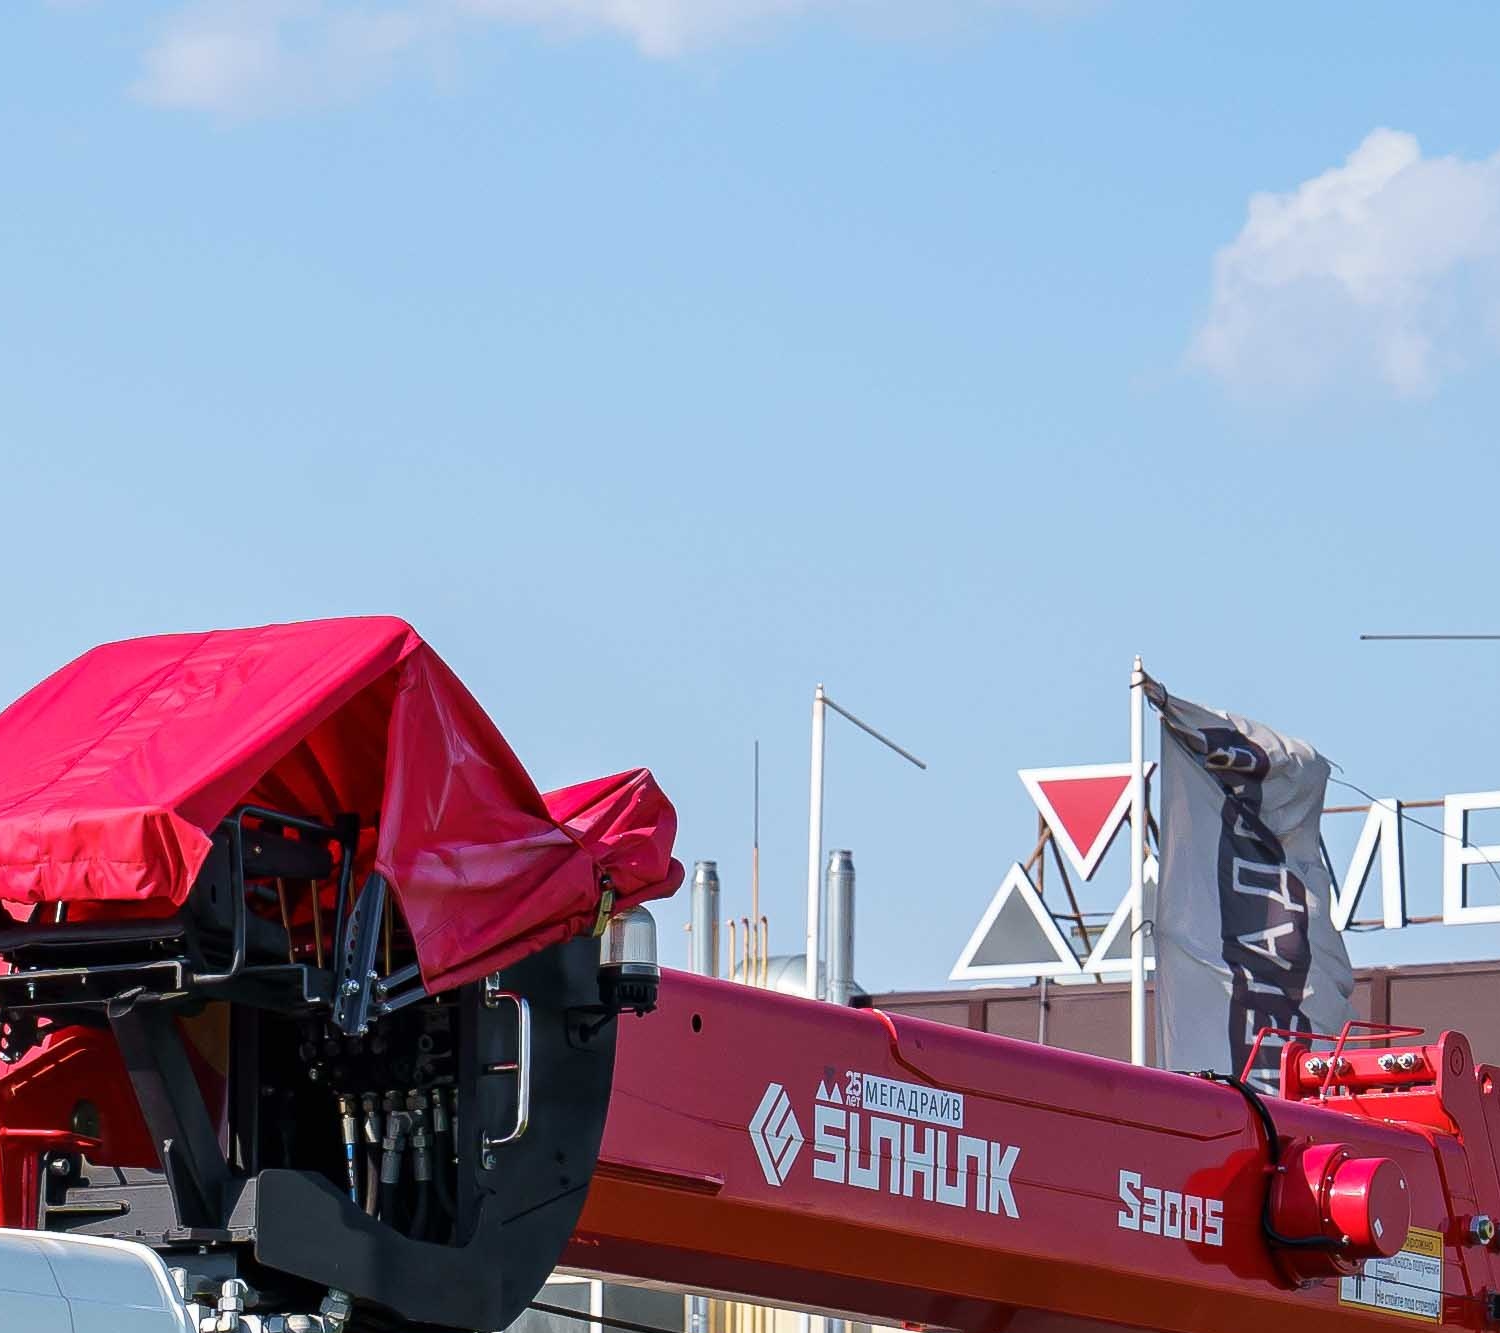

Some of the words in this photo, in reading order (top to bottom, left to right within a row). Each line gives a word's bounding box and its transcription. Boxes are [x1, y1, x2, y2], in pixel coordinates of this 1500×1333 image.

[845, 1070, 861, 1097] 25
[846, 1095, 860, 1107] лет
[865, 1080, 961, 1121] МЕГАДРАЙВ
